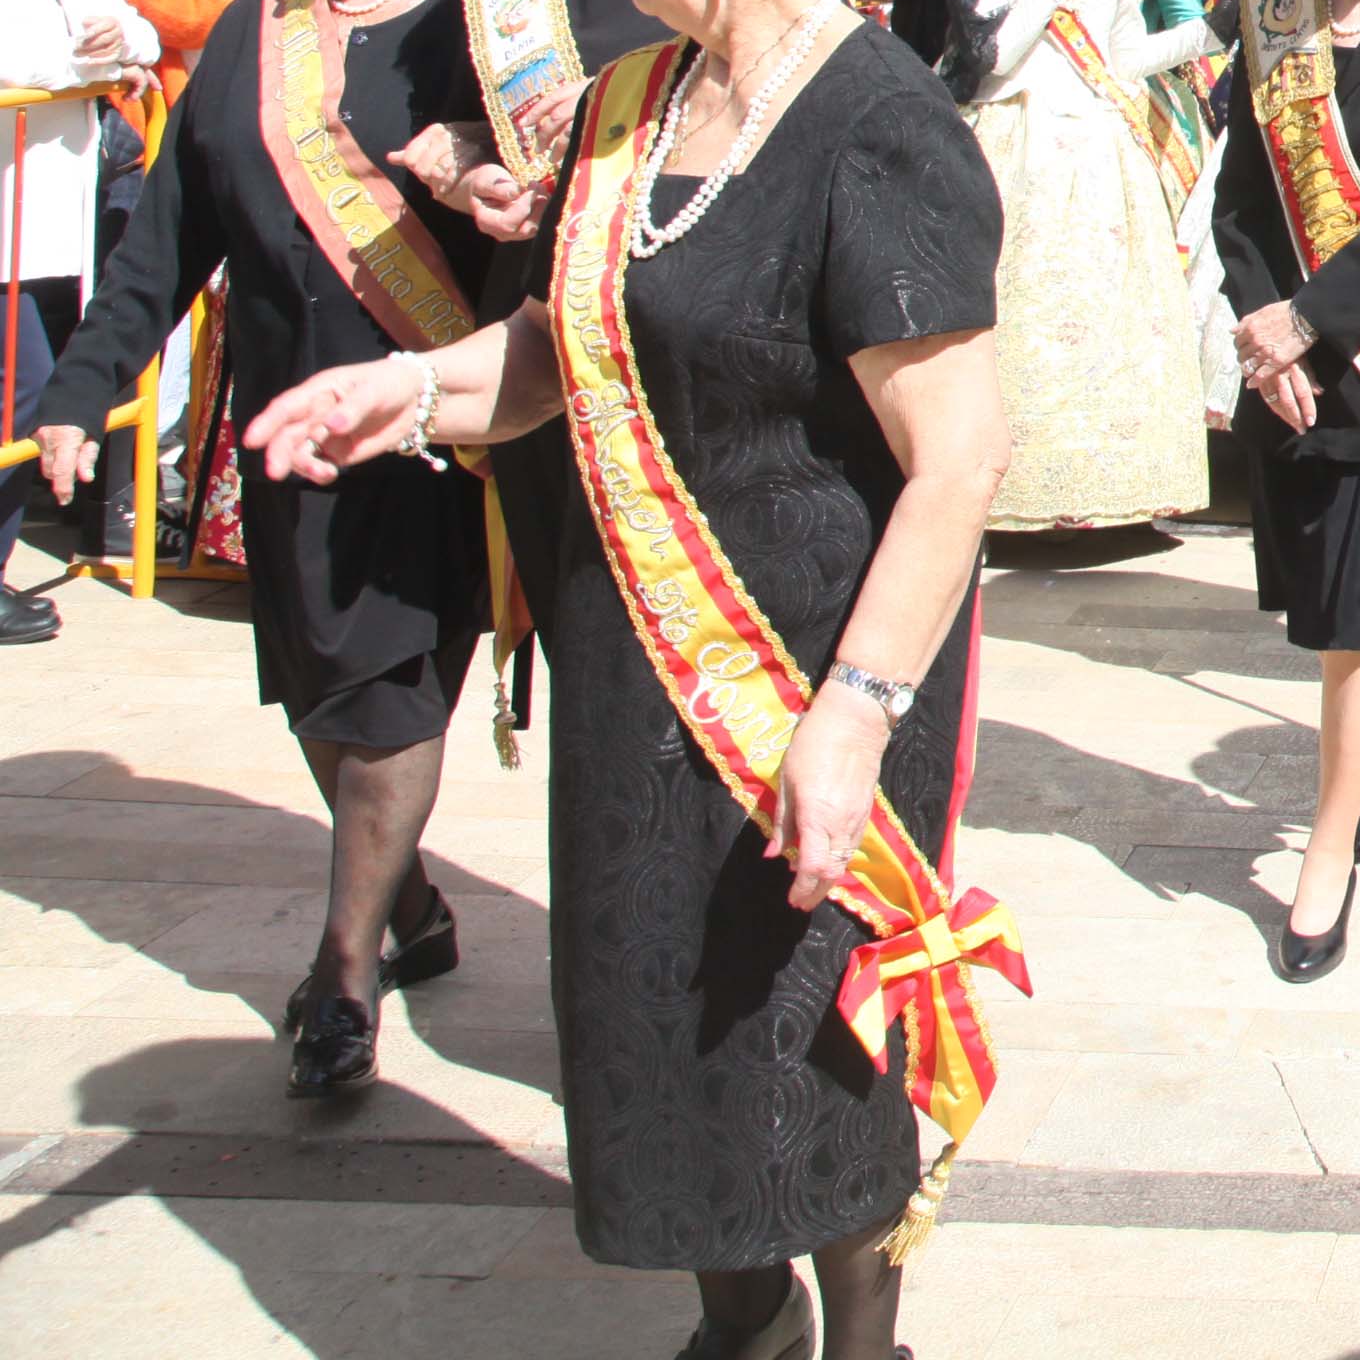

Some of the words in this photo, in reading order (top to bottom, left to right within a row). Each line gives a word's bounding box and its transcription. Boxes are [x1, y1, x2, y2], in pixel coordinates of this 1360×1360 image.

[325, 183, 414, 298] Centro
[408, 288, 475, 346] 195
[569, 377, 673, 561] Mayor
